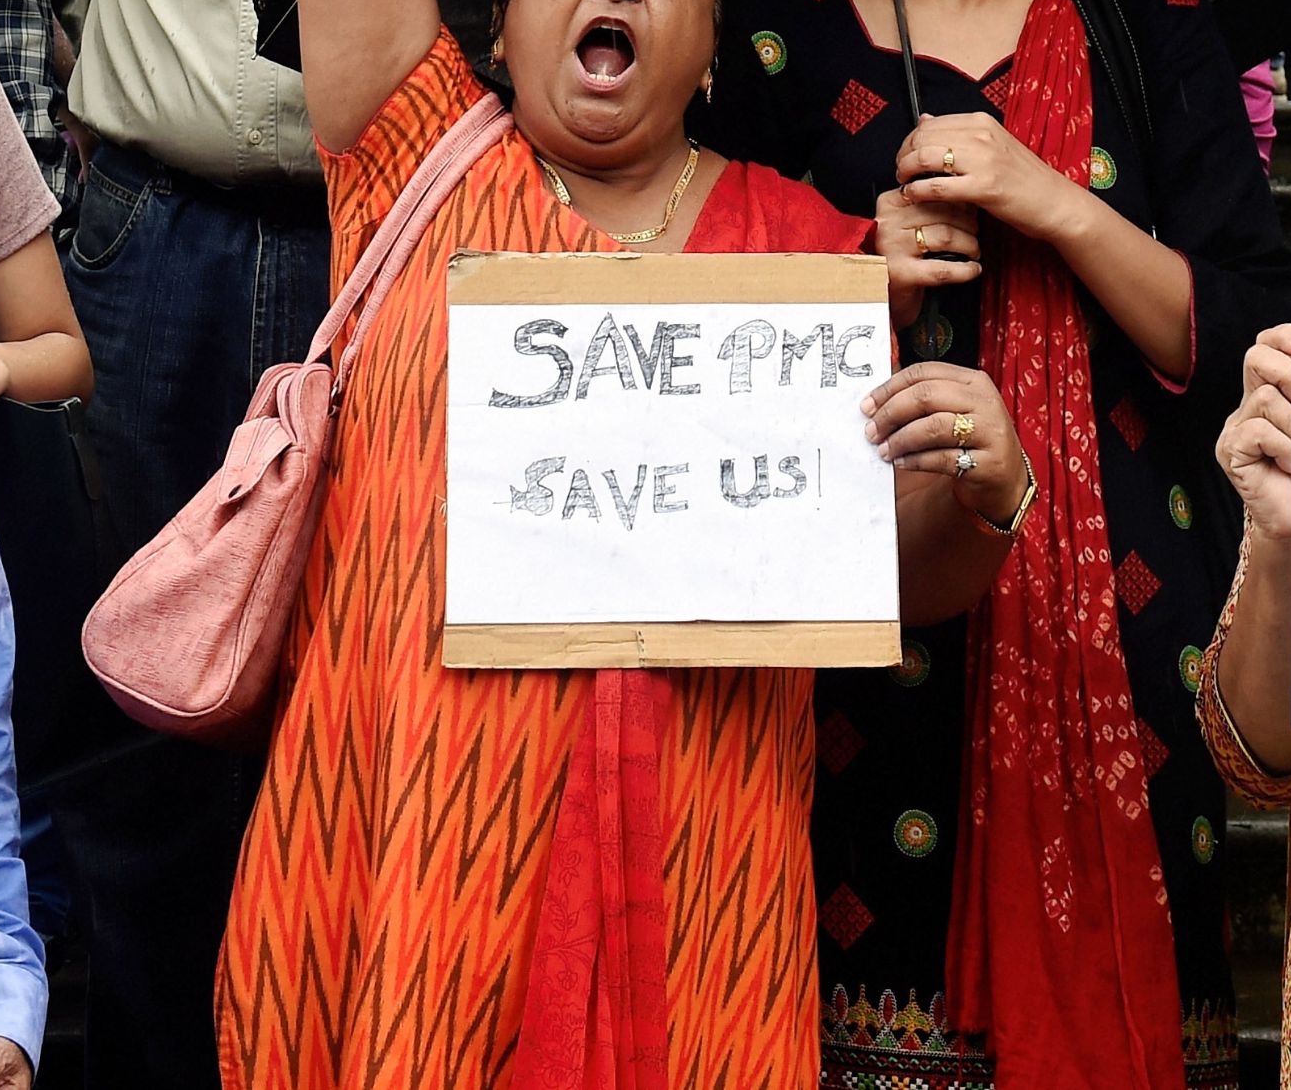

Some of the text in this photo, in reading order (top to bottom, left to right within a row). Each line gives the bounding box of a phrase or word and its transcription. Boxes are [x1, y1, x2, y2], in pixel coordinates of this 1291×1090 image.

[488, 311, 876, 409] SAVE PMC
[509, 455, 690, 532] SAVE
